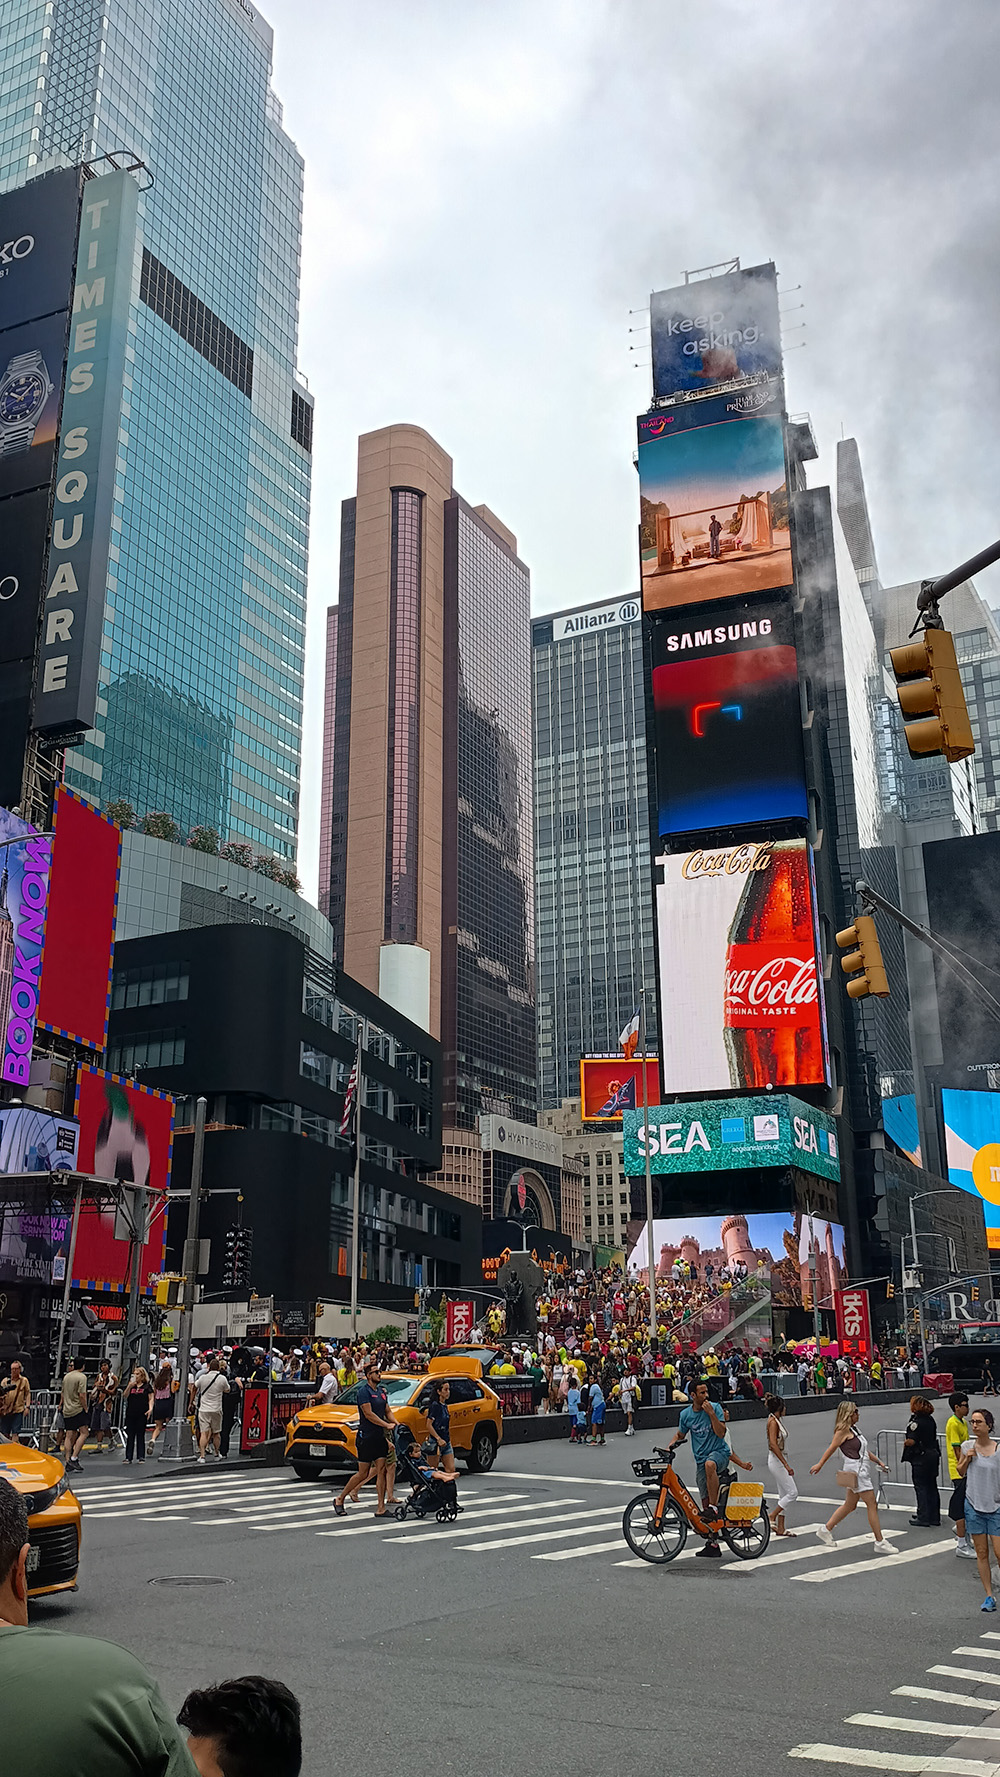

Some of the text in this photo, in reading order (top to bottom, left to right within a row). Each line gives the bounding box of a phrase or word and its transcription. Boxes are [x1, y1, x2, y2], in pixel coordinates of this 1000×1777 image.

[68, 198, 109, 395] TIMES
[667, 311, 724, 336] keep
[683, 326, 765, 355] asking.
[640, 417, 675, 429] THAILAND
[42, 426, 89, 692] SQUARE
[563, 611, 615, 634] Allianz
[667, 619, 772, 652] SAMSUNG
[682, 841, 776, 880] Coca-Cola
[3, 825, 55, 1086] BOOK NOW
[762, 1007, 797, 1016] TASTE
[508, 1133, 529, 1146] HYATT
[638, 1121, 711, 1157] SEA
[794, 1116, 819, 1156] SEA
[58, 1219, 68, 1230] AT
[843, 1293, 863, 1337] tkts
[947, 1292, 978, 1321] R
[249, 1427, 260, 1438] MJ
[679, 1489, 698, 1516] JOCO
